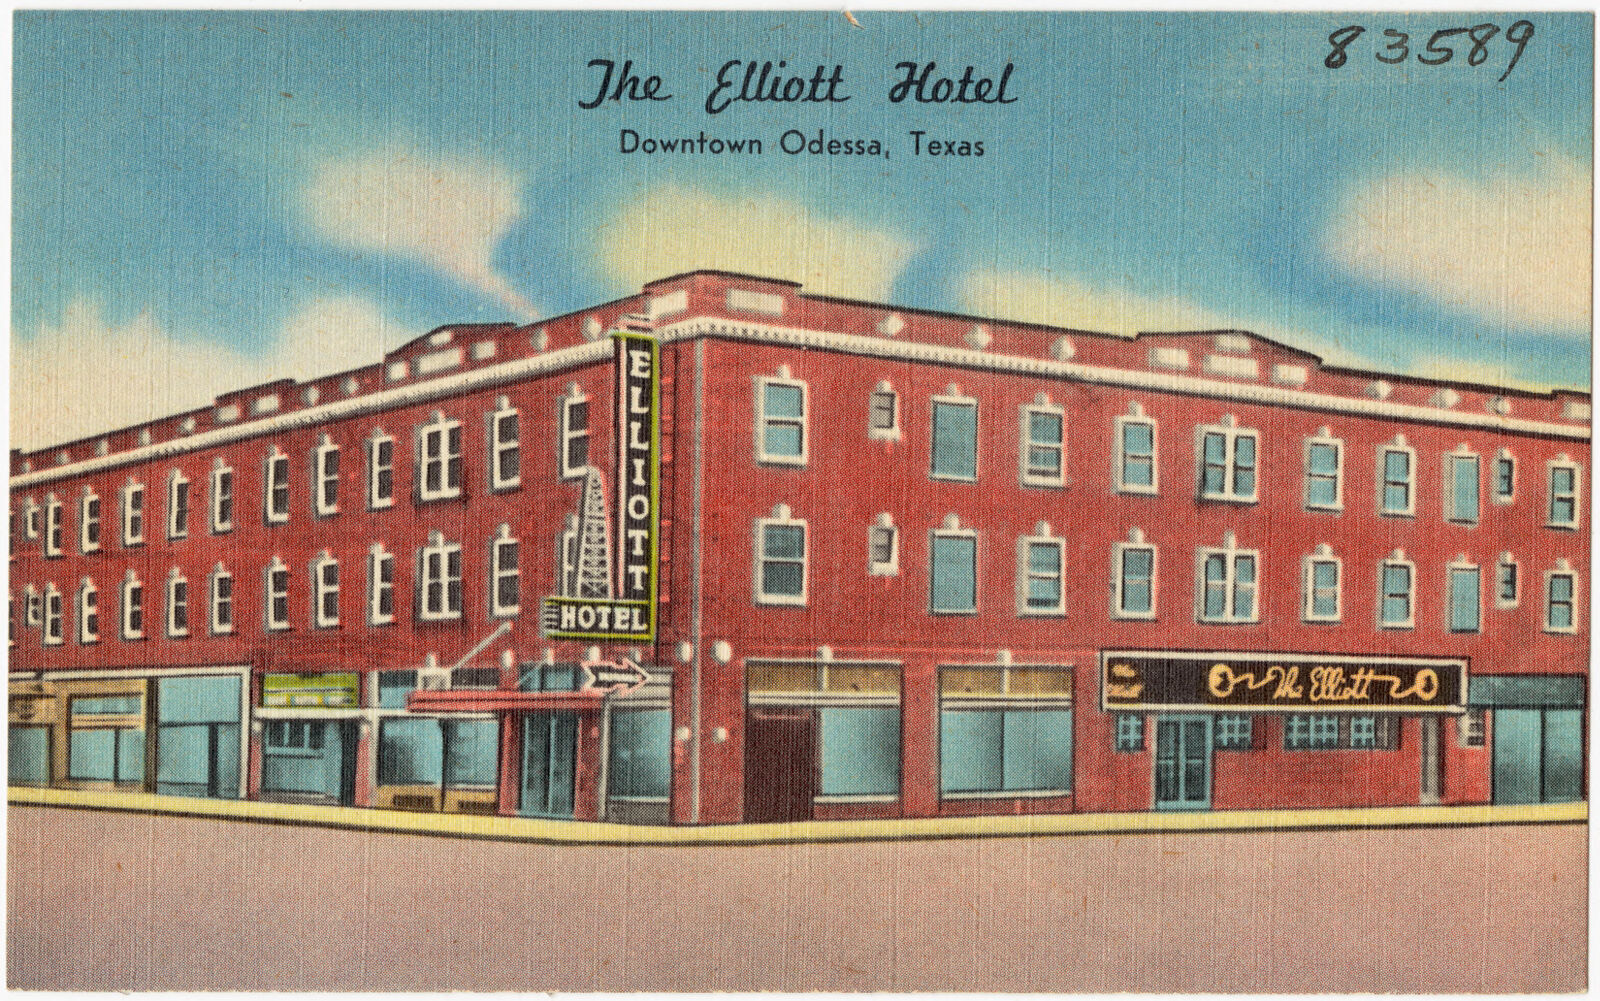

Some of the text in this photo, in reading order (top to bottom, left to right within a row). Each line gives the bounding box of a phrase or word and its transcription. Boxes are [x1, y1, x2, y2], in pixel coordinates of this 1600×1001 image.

[1324, 19, 1536, 83] 83589
[628, 350, 651, 591] ELLIOTT
[560, 604, 649, 631] HOTEL
[1271, 665, 1372, 702] The Elliott
